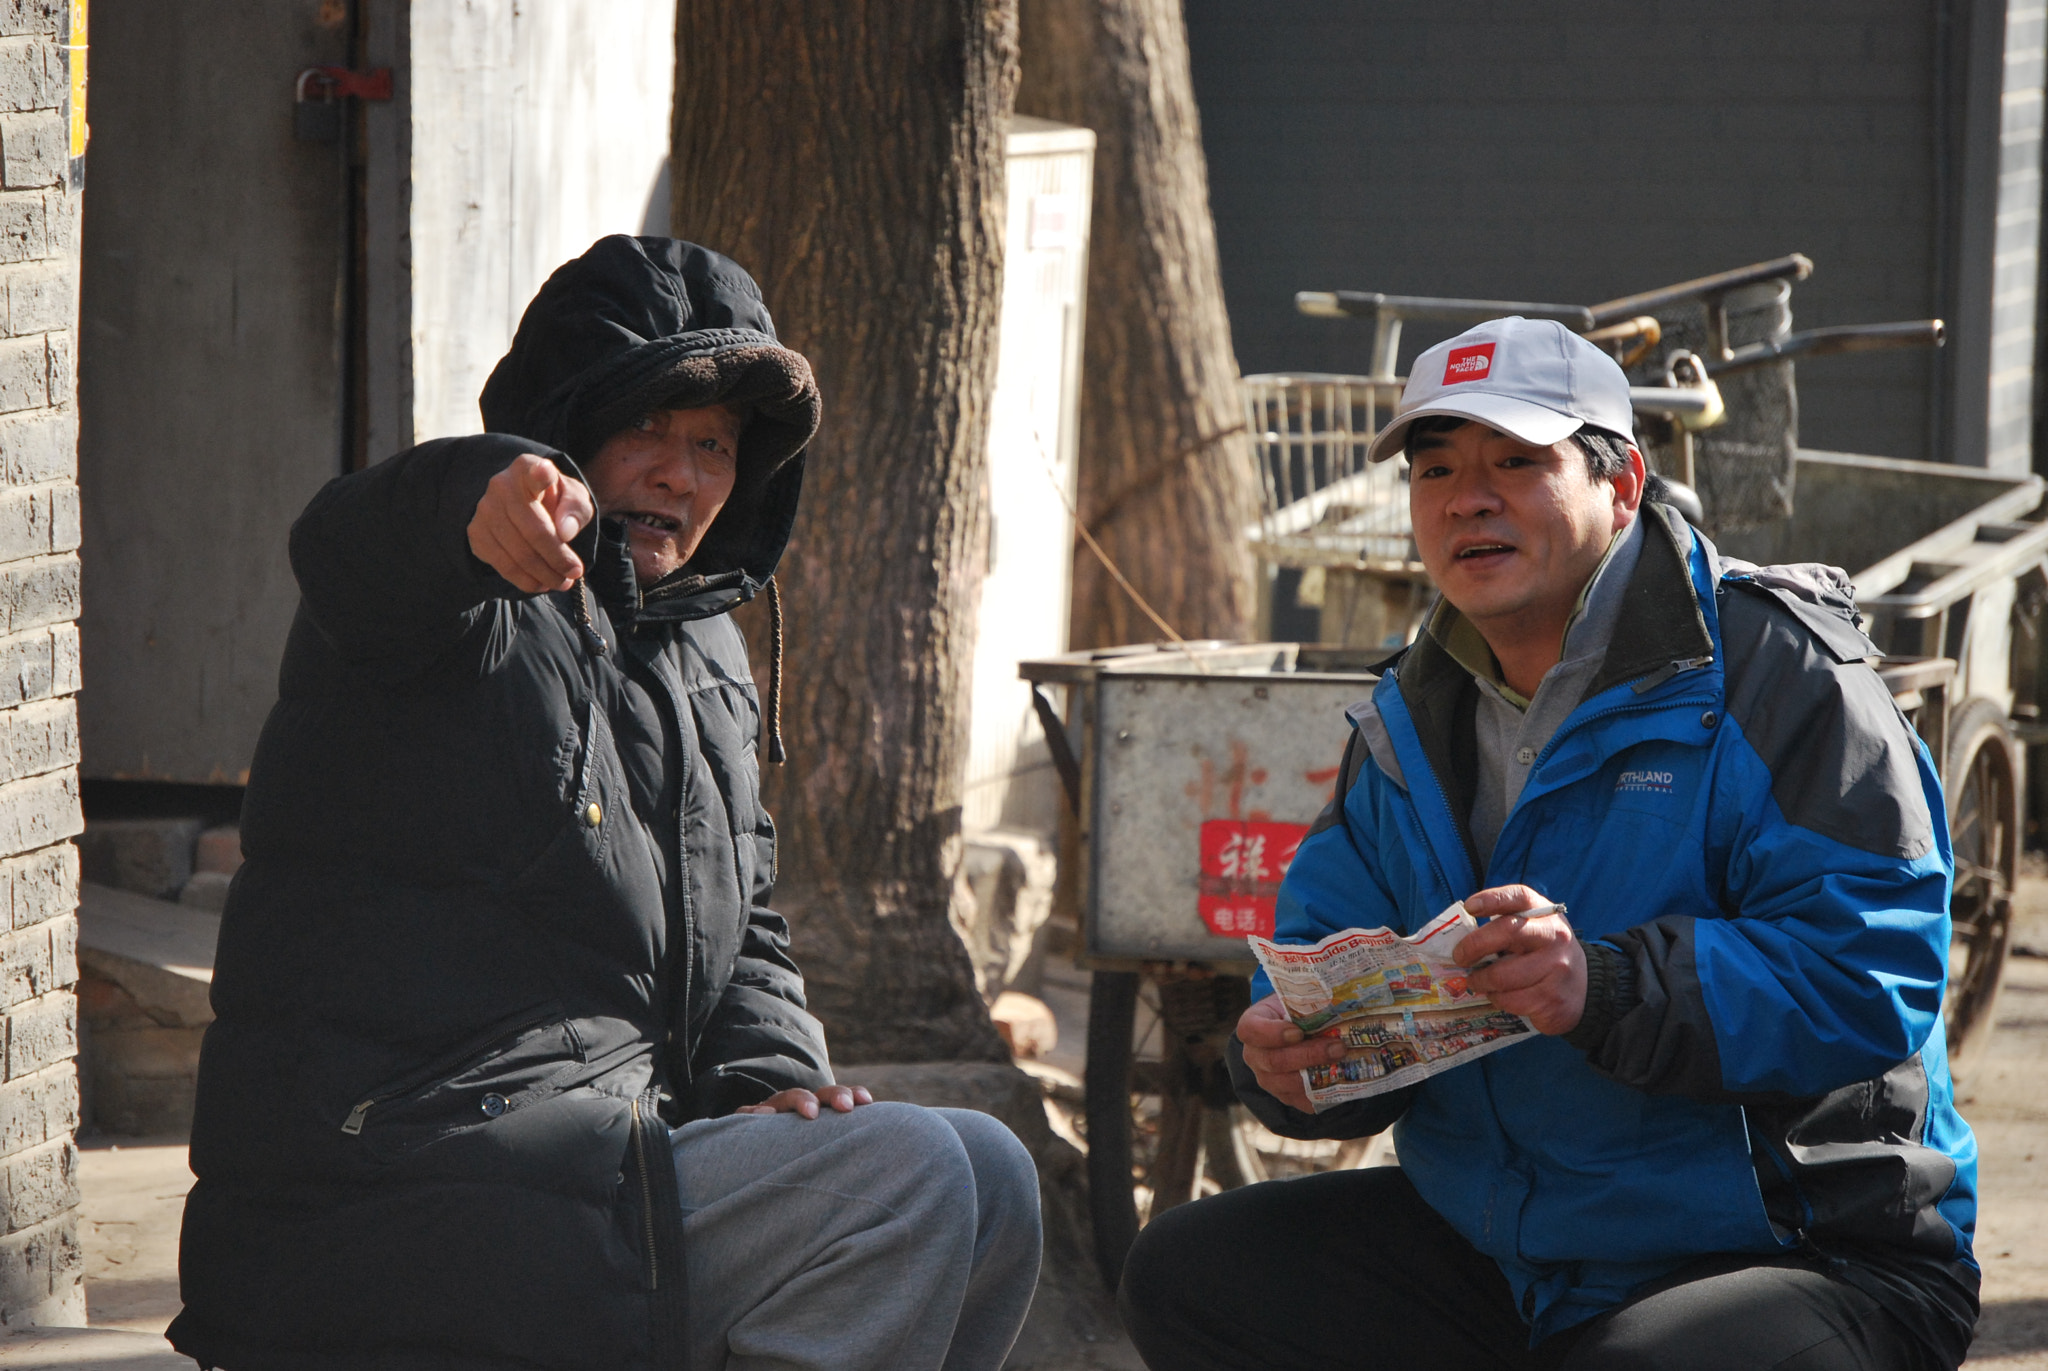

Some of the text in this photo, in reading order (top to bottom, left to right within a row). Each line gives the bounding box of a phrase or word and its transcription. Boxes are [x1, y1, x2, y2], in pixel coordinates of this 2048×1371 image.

[1450, 361, 1475, 370] NORTH
[1616, 771, 1673, 785] RTHLAND
[1310, 943, 1348, 964] Inside
[1348, 935, 1395, 950] Beijing
